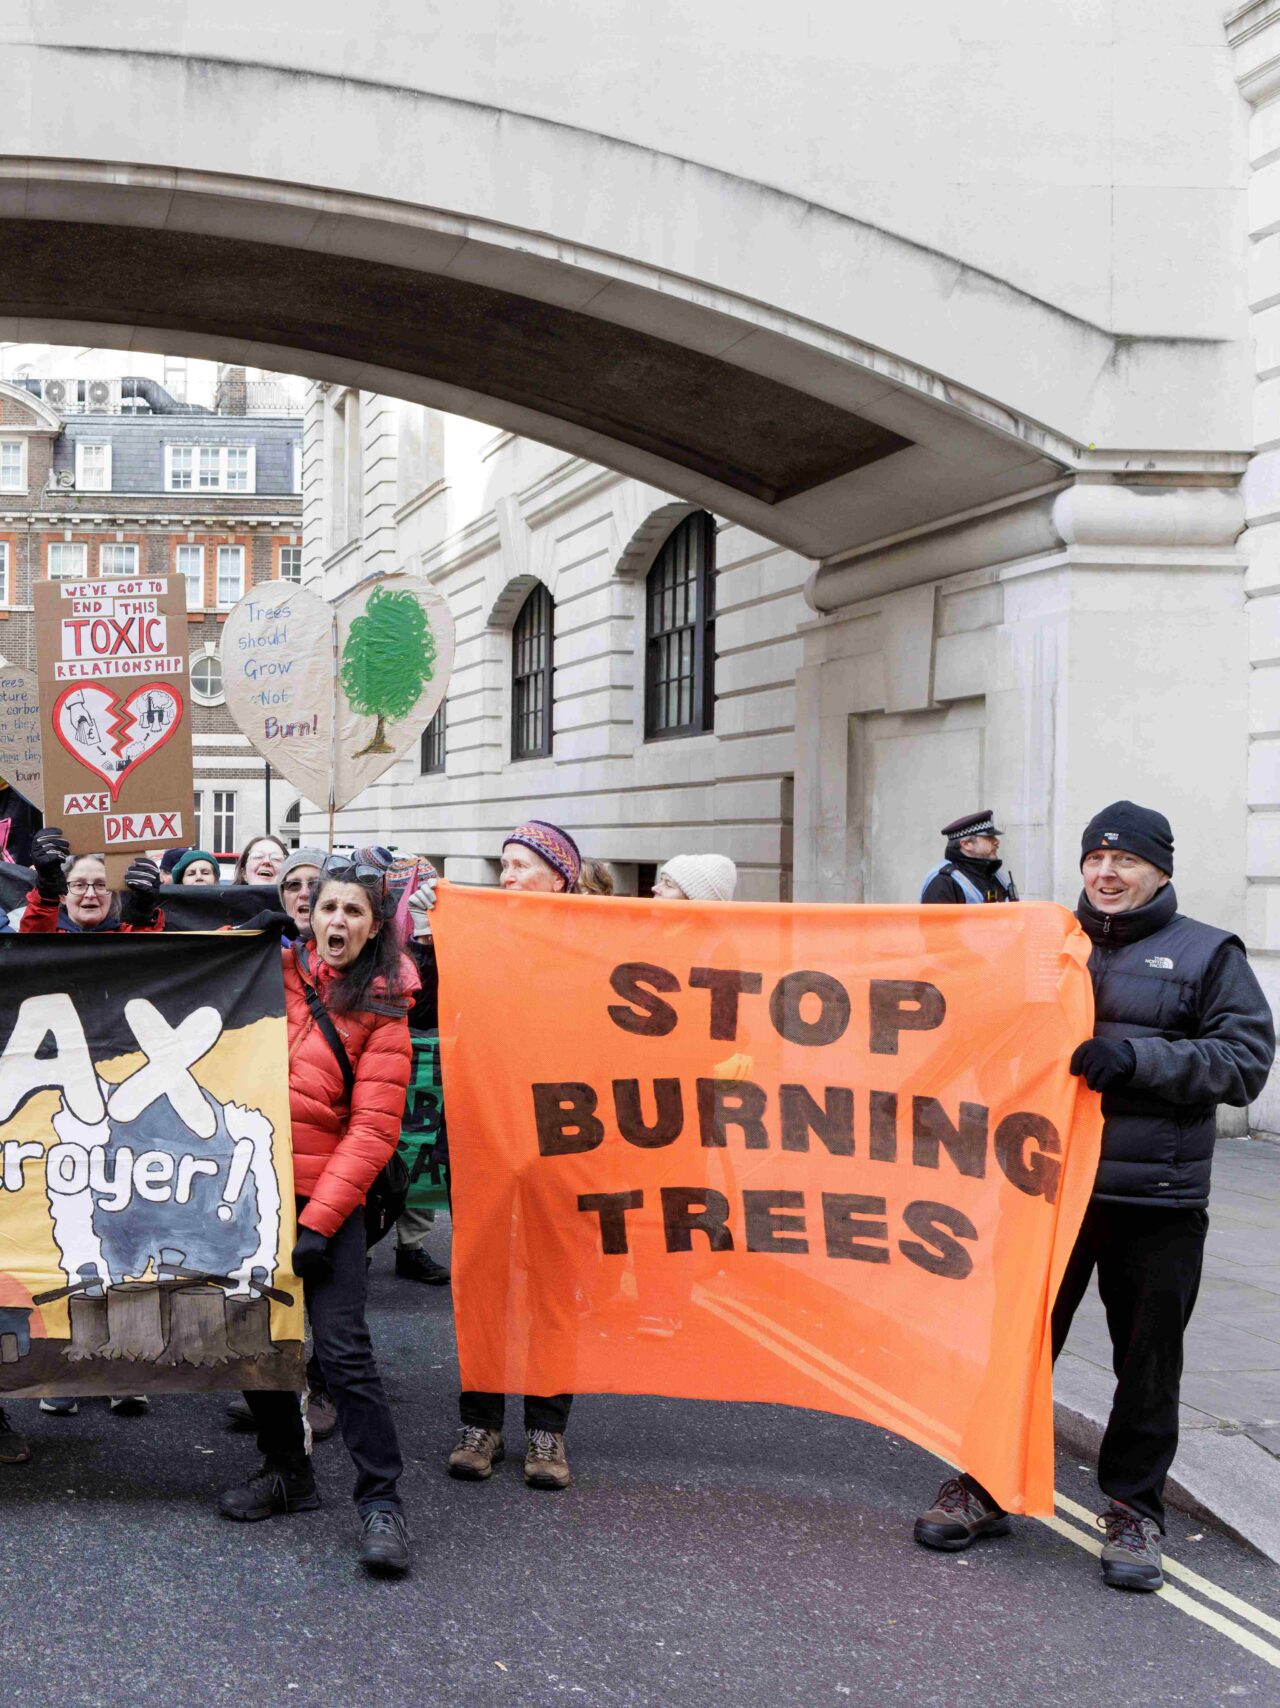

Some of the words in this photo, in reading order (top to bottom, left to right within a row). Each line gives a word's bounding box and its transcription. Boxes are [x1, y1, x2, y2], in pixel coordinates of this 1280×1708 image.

[65, 583, 107, 597] WE'VE
[117, 583, 143, 594] GOT
[148, 581, 162, 593] TO
[73, 602, 102, 613] END
[120, 601, 155, 615] THIS
[244, 602, 292, 623] Trees
[64, 616, 164, 656] TOXIC
[238, 624, 287, 650] should
[57, 658, 182, 678] RELATIONSHIP
[244, 659, 293, 680] Grow
[260, 689, 288, 706] Not
[264, 714, 318, 739] Burn!
[65, 793, 109, 814] AXE
[106, 813, 178, 841] DRAX
[607, 962, 947, 1055] STOP
[531, 1077, 1063, 1205] BURNING
[577, 1187, 978, 1280] TREES
